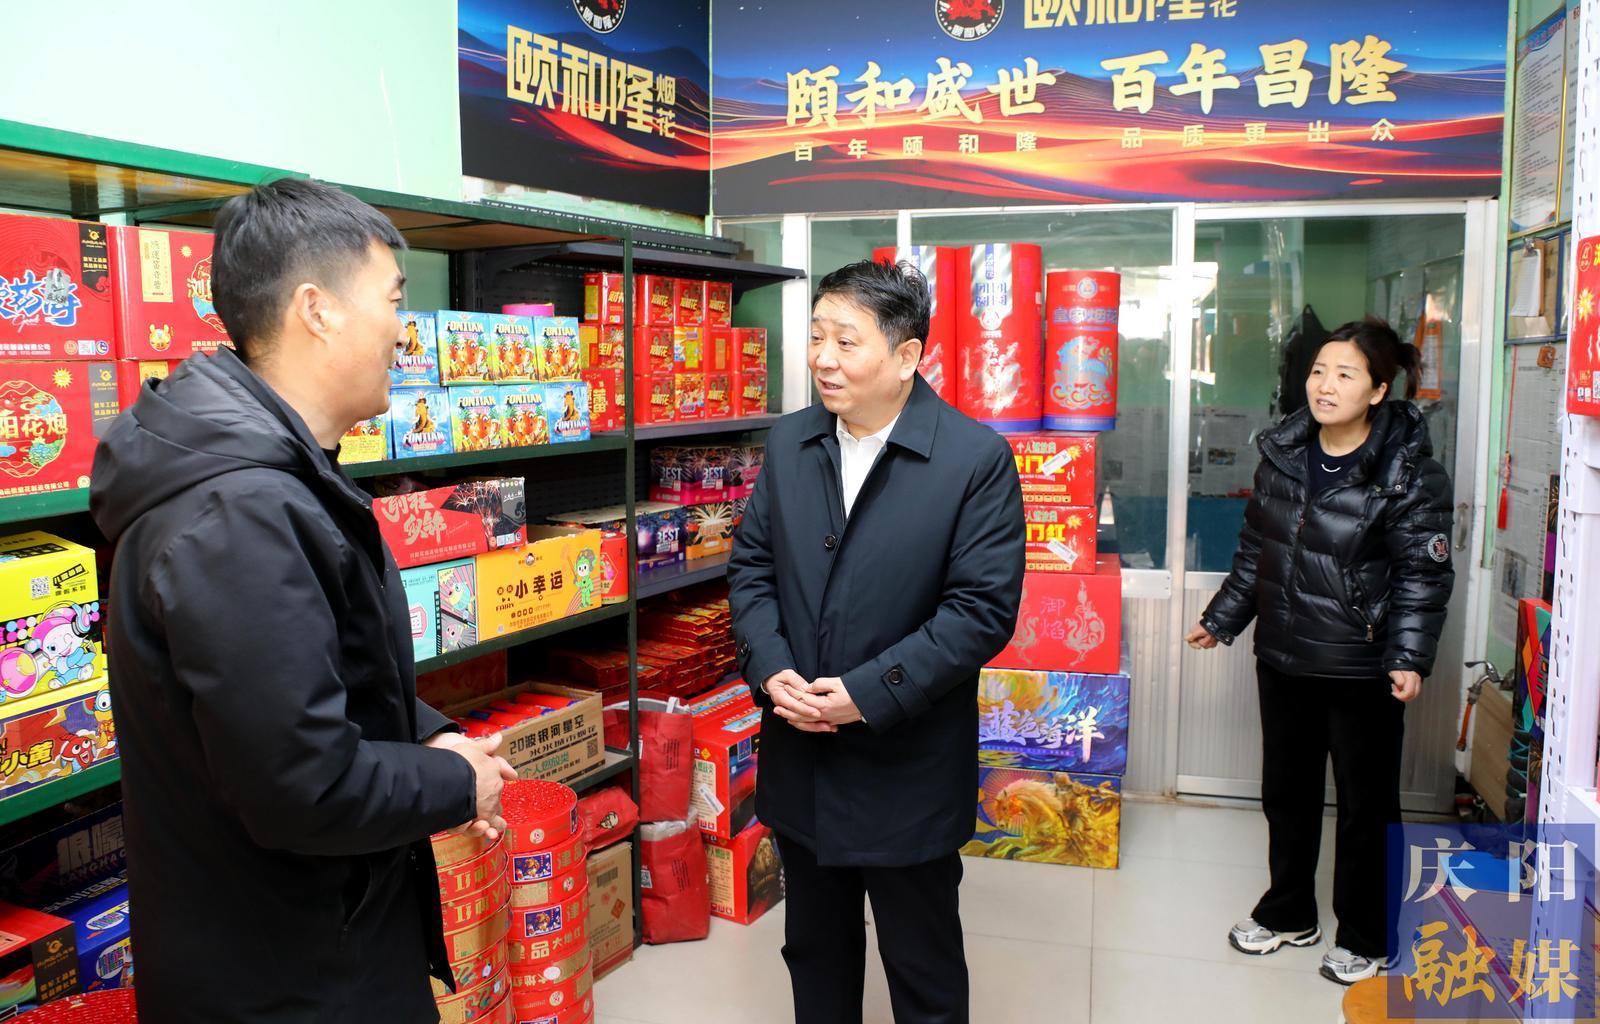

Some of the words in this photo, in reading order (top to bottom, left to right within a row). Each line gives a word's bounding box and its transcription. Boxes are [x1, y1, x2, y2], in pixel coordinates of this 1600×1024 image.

[506, 24, 654, 134] 颐和隆
[655, 73, 677, 139] 烟花
[1101, 34, 1408, 115] 百年昌隆
[794, 132, 1038, 163] 百年颐和隆
[1121, 118, 1396, 149] 品质更出众
[661, 467, 683, 481] BEST
[703, 466, 725, 479] BEST
[656, 528, 680, 542] BEST
[514, 570, 564, 599] 小幸运
[509, 714, 585, 756] 20波银河星空
[978, 699, 1105, 763] 蓝色海洋
